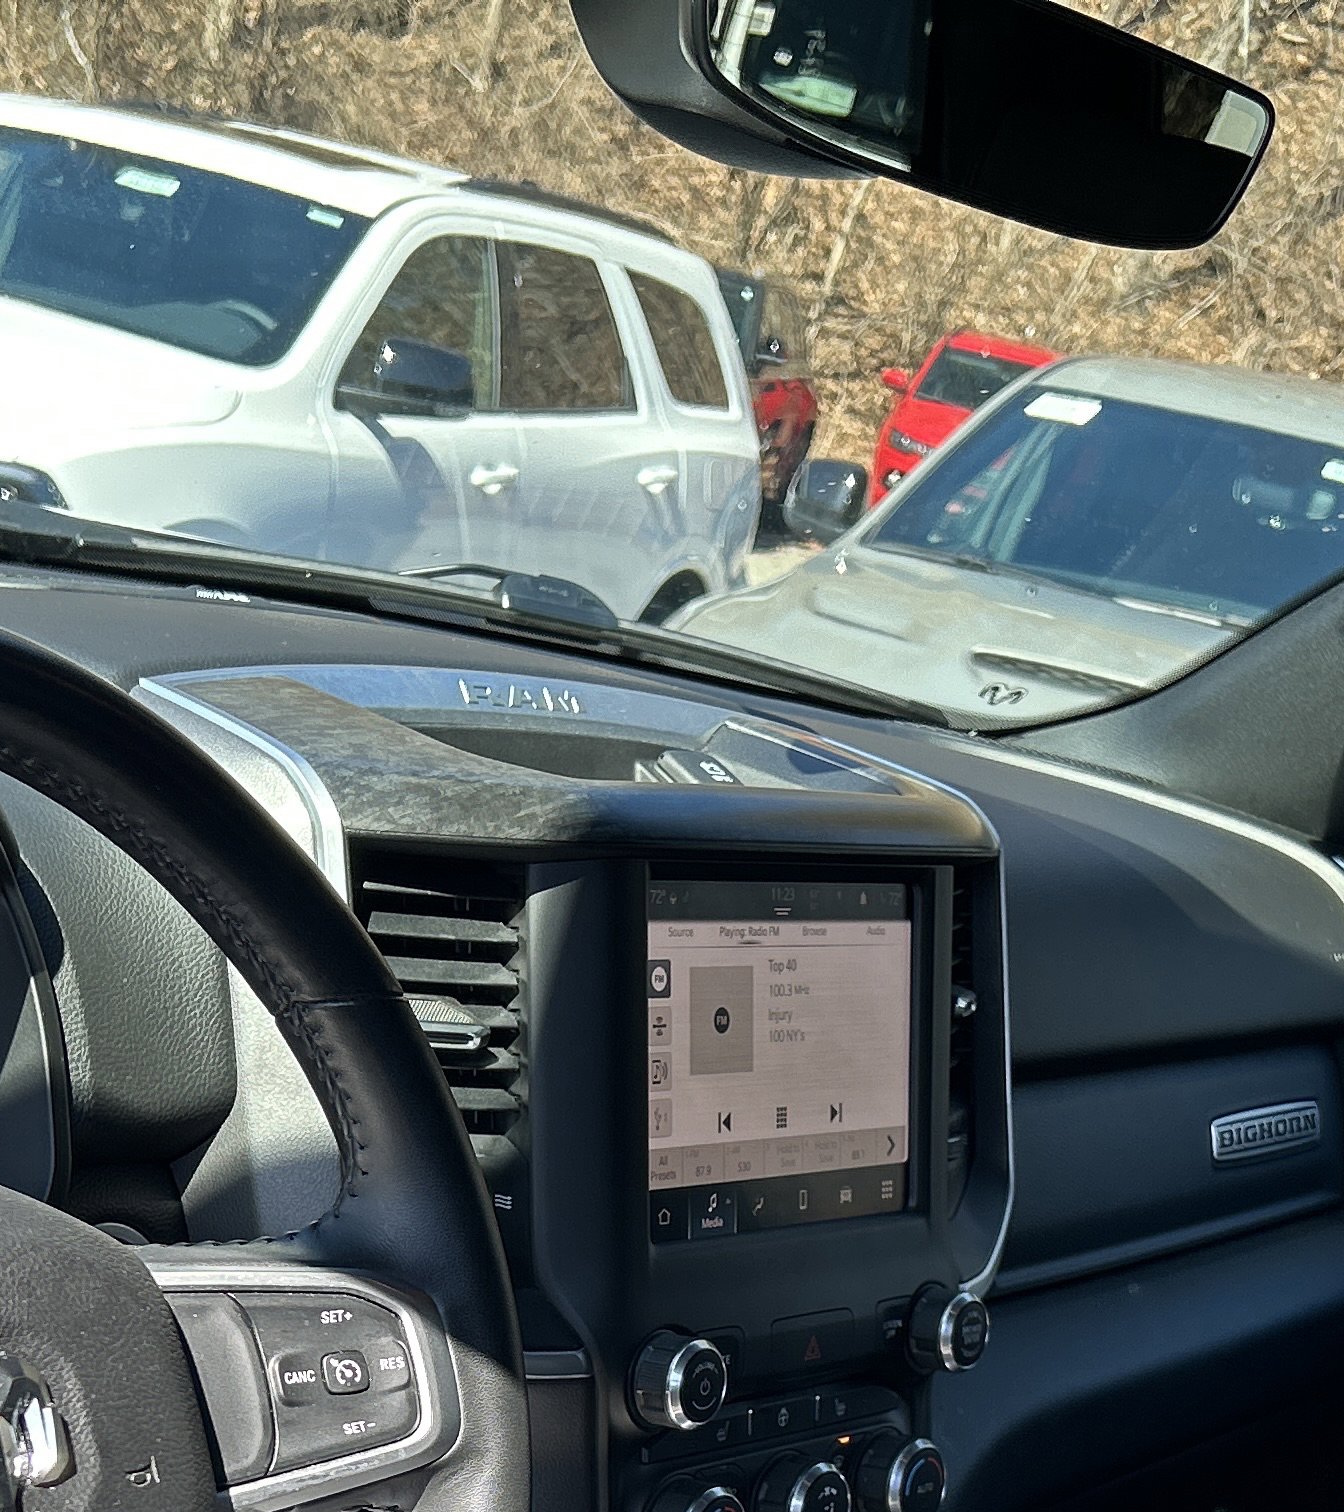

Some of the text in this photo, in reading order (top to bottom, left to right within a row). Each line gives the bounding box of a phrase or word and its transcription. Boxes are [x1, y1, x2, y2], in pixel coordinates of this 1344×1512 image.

[458, 678, 587, 715] RAM
[768, 959, 798, 975] Top 40
[769, 983, 793, 998] 100.3
[1218, 1112, 1318, 1149] BIGHORN
[701, 1217, 723, 1229] Media
[379, 1356, 406, 1371] RES
[284, 1369, 316, 1385] CANC
